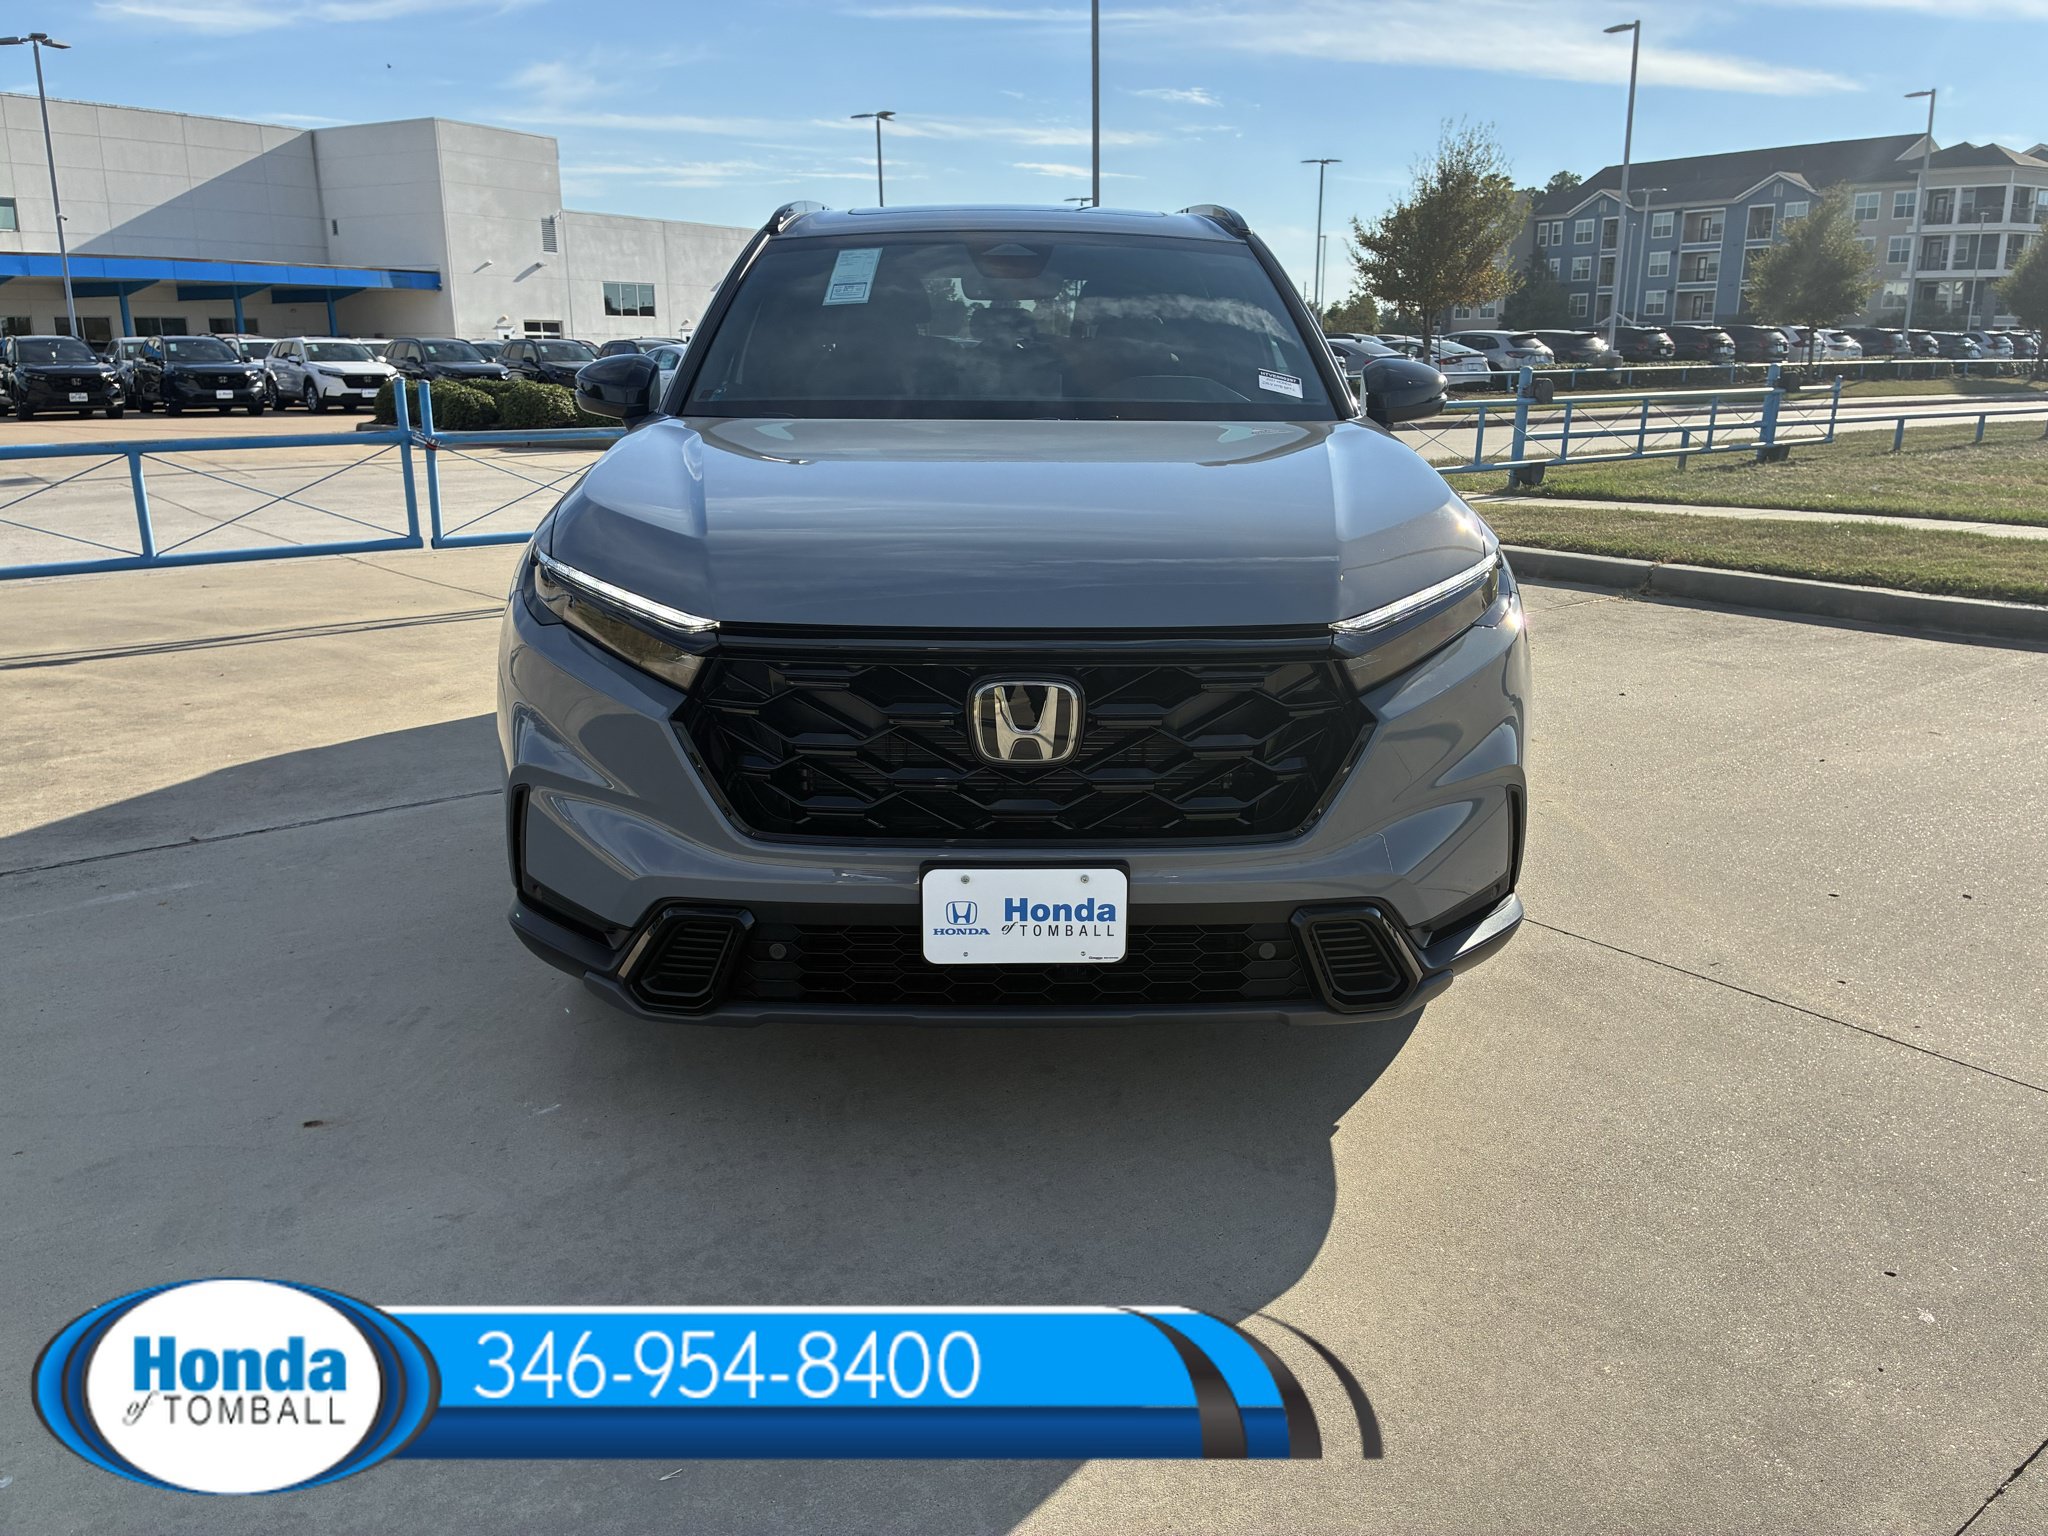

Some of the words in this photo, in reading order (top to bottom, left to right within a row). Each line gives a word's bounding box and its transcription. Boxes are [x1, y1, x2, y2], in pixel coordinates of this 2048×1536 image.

[1004, 897, 1116, 922] Honda
[932, 928, 991, 936] HONDA
[1001, 921, 1019, 935] of
[1020, 924, 1115, 937] TOMBALL
